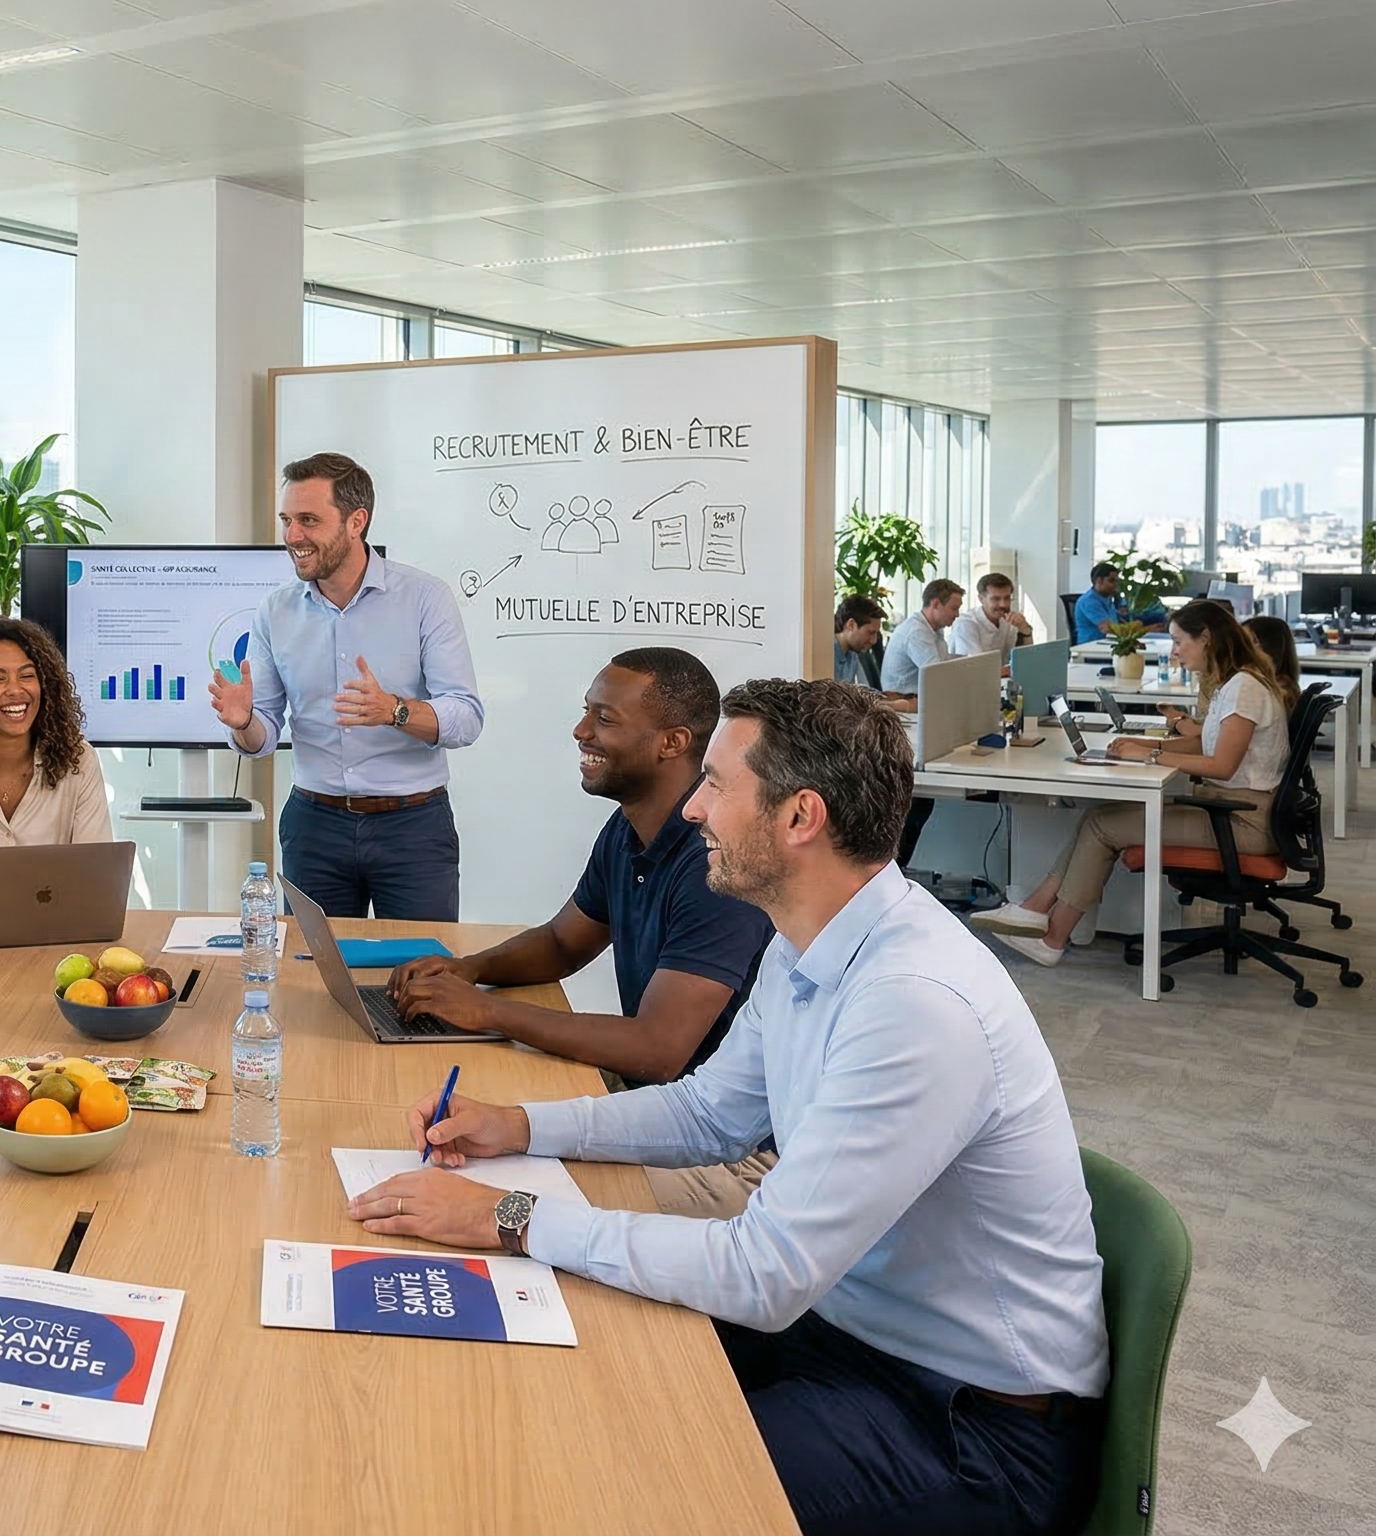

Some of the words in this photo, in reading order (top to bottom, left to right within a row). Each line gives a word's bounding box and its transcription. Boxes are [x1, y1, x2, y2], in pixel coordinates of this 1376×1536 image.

[433, 430, 585, 460] RECRUTEMENT
[593, 425, 611, 454] &
[91, 565, 113, 573] SANTÉ
[495, 596, 600, 623] MUTUELLE
[373, 1275, 399, 1313] VOTRE
[392, 1272, 428, 1316] SANTÉ
[425, 1267, 456, 1318] GROUPE
